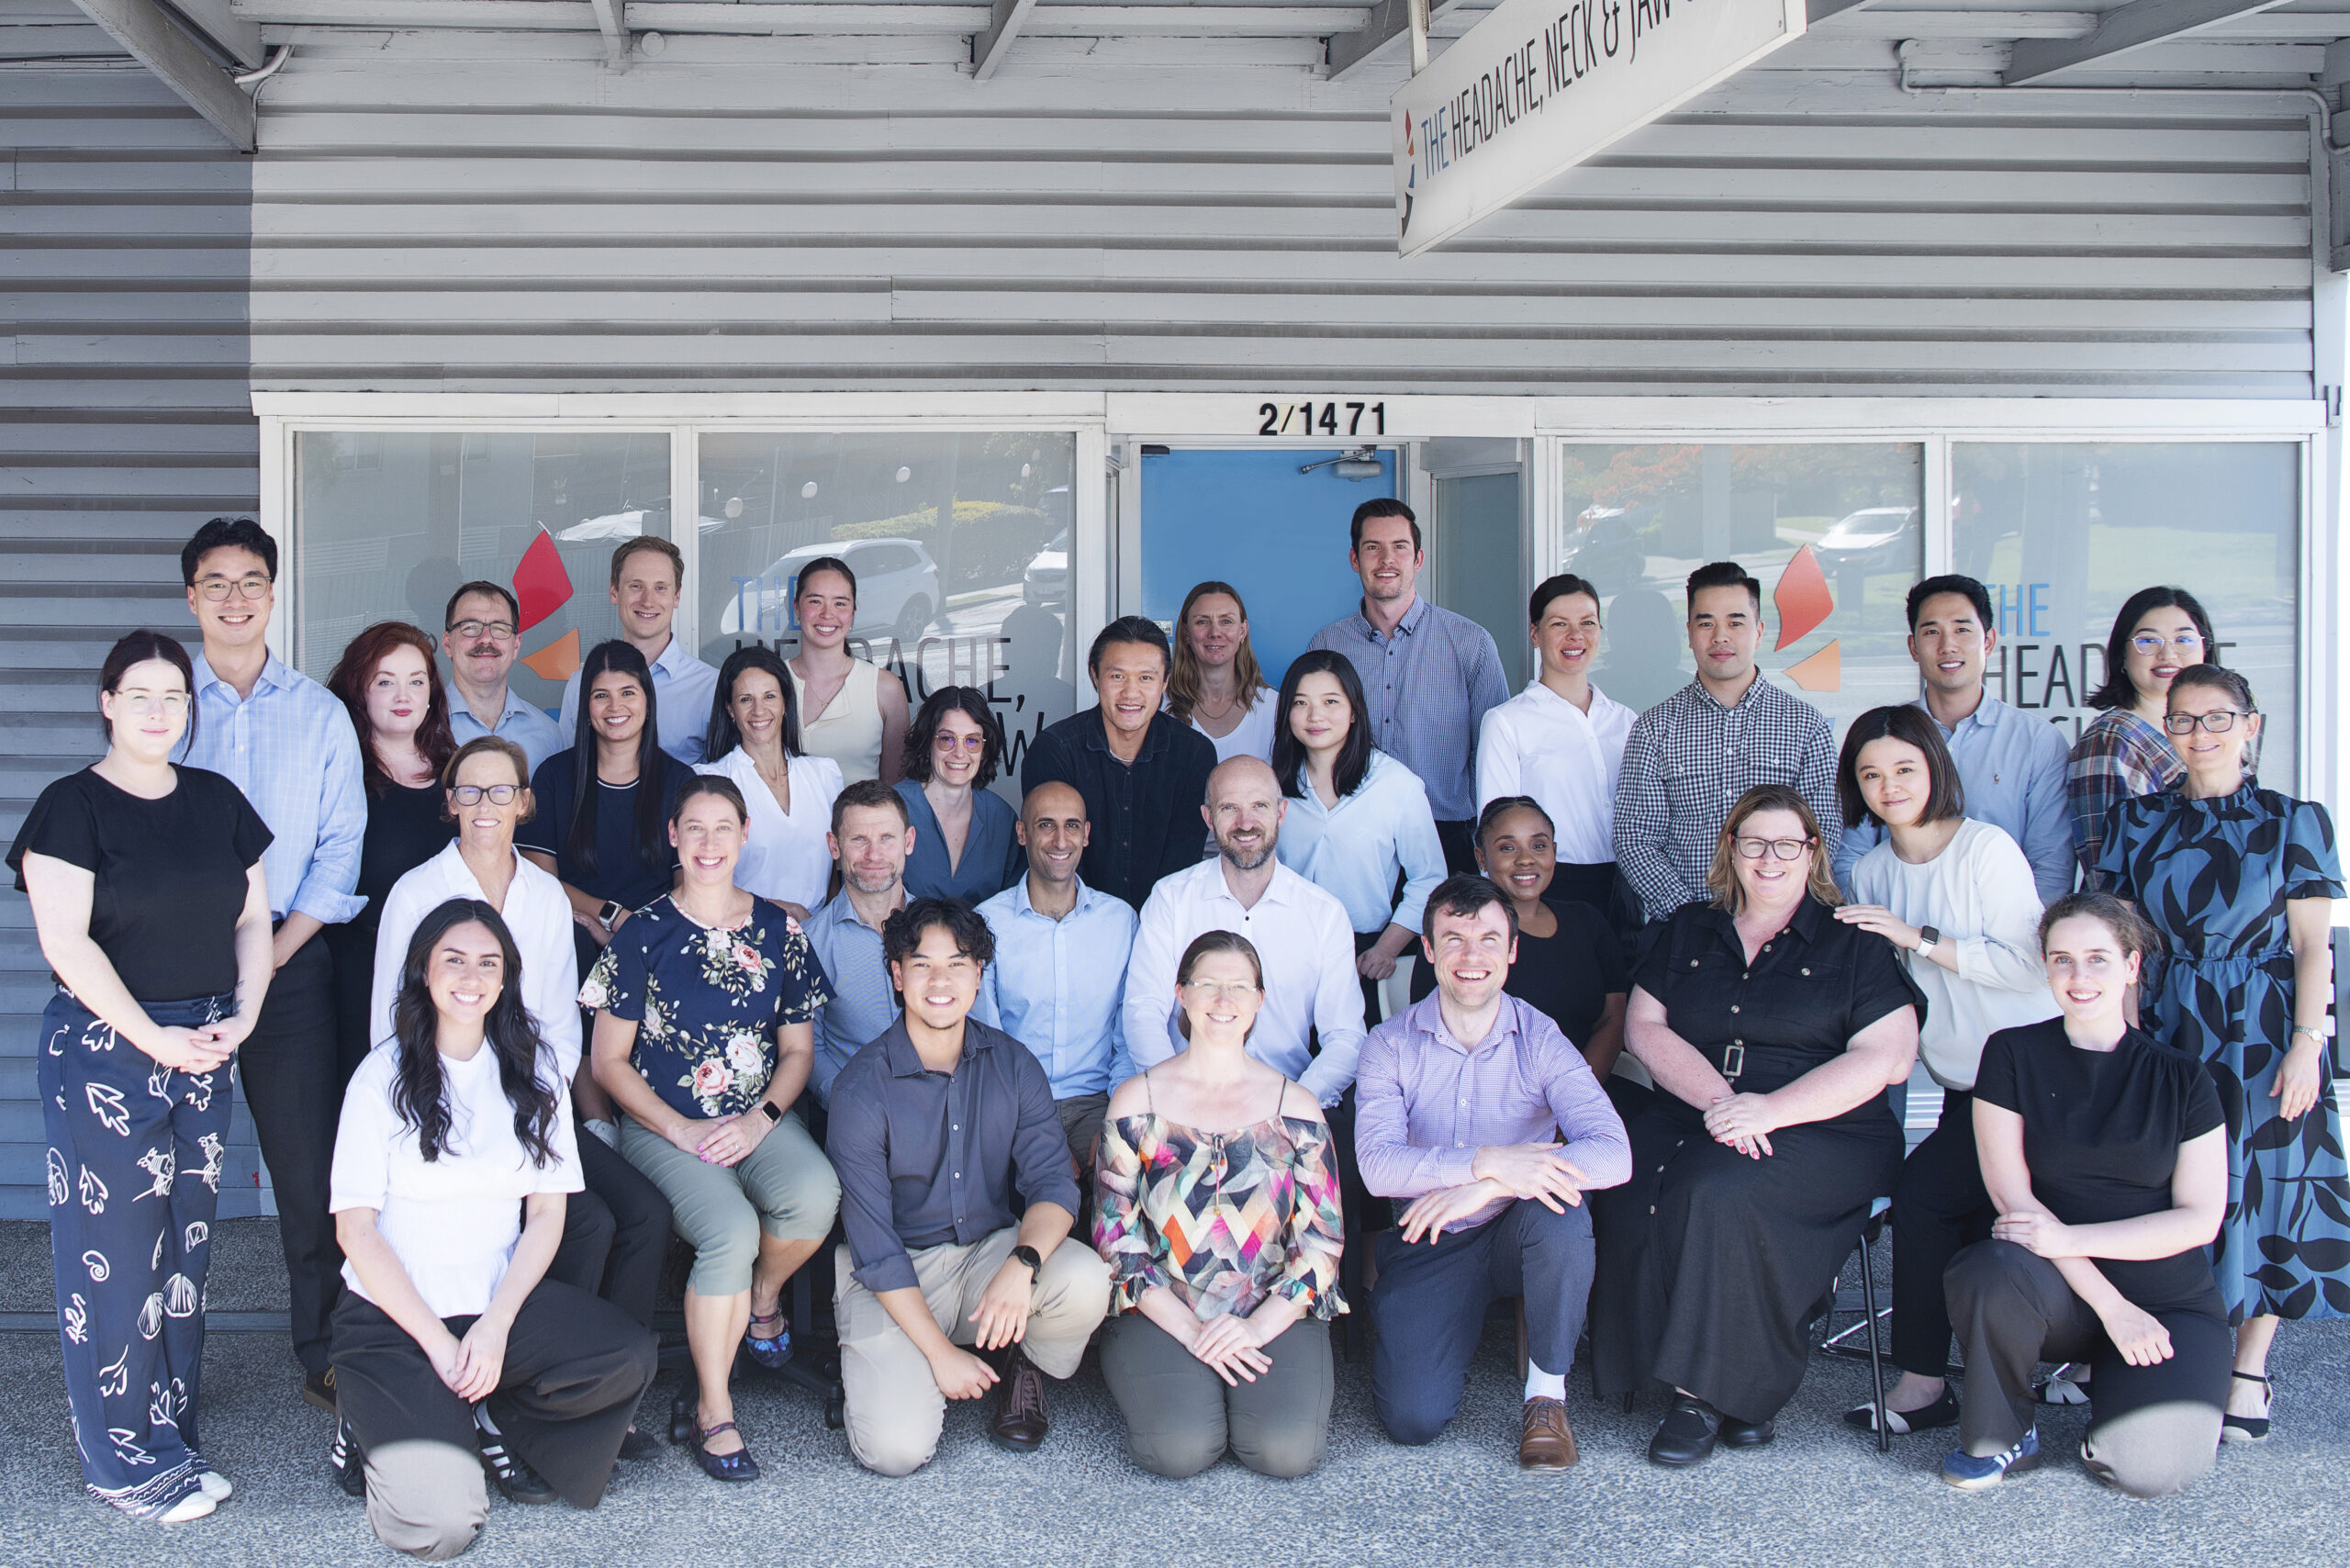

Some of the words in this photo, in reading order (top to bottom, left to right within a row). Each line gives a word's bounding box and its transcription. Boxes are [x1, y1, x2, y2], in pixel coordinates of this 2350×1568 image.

[1421, 106, 1449, 180] THE
[1450, 38, 1543, 162] HEADACHE,
[1545, 0, 1597, 97] NECK
[1602, 0, 1620, 57] &
[1259, 401, 1384, 436] 2/1471
[1986, 582, 2051, 636] HE
[735, 637, 1025, 712] ACHE,
